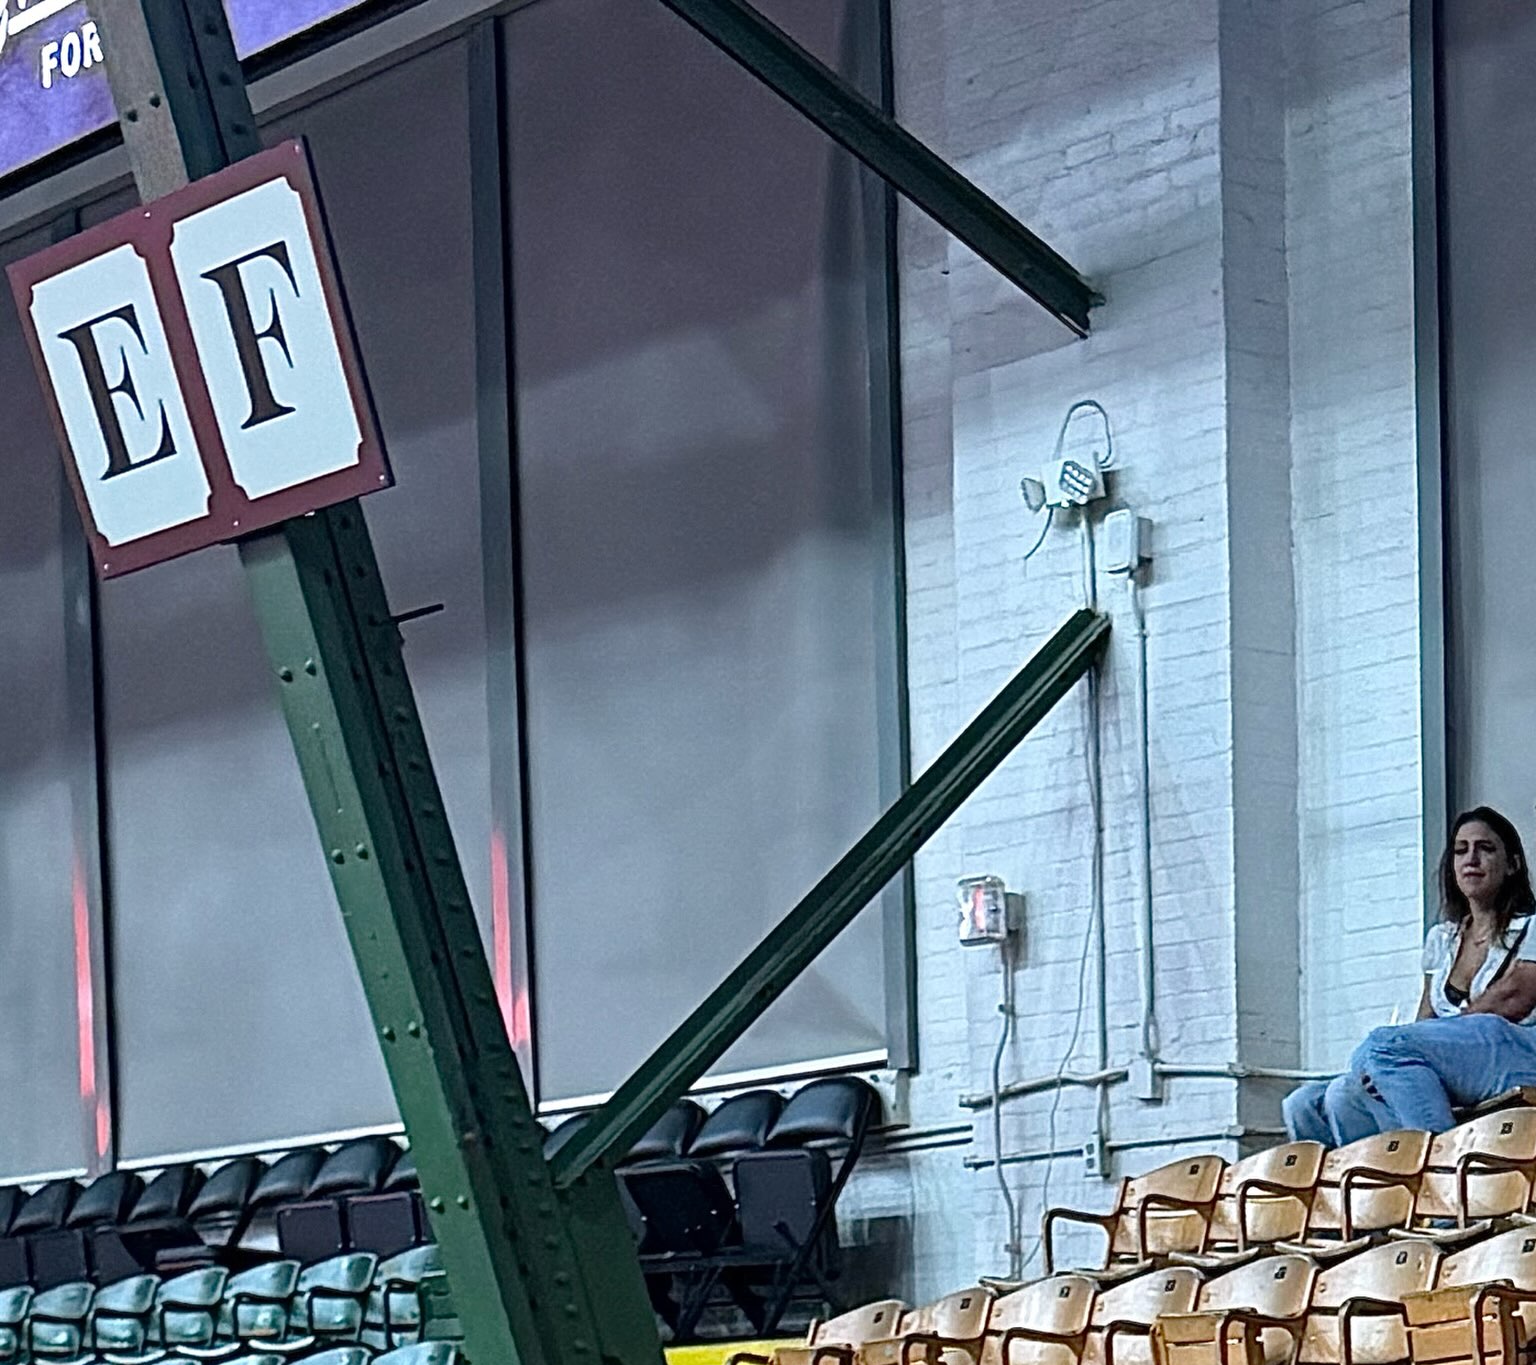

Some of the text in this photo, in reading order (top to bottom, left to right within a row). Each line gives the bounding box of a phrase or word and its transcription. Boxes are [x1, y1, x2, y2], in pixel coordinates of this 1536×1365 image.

[41, 21, 104, 89] FOR
[57, 241, 300, 480] E F
